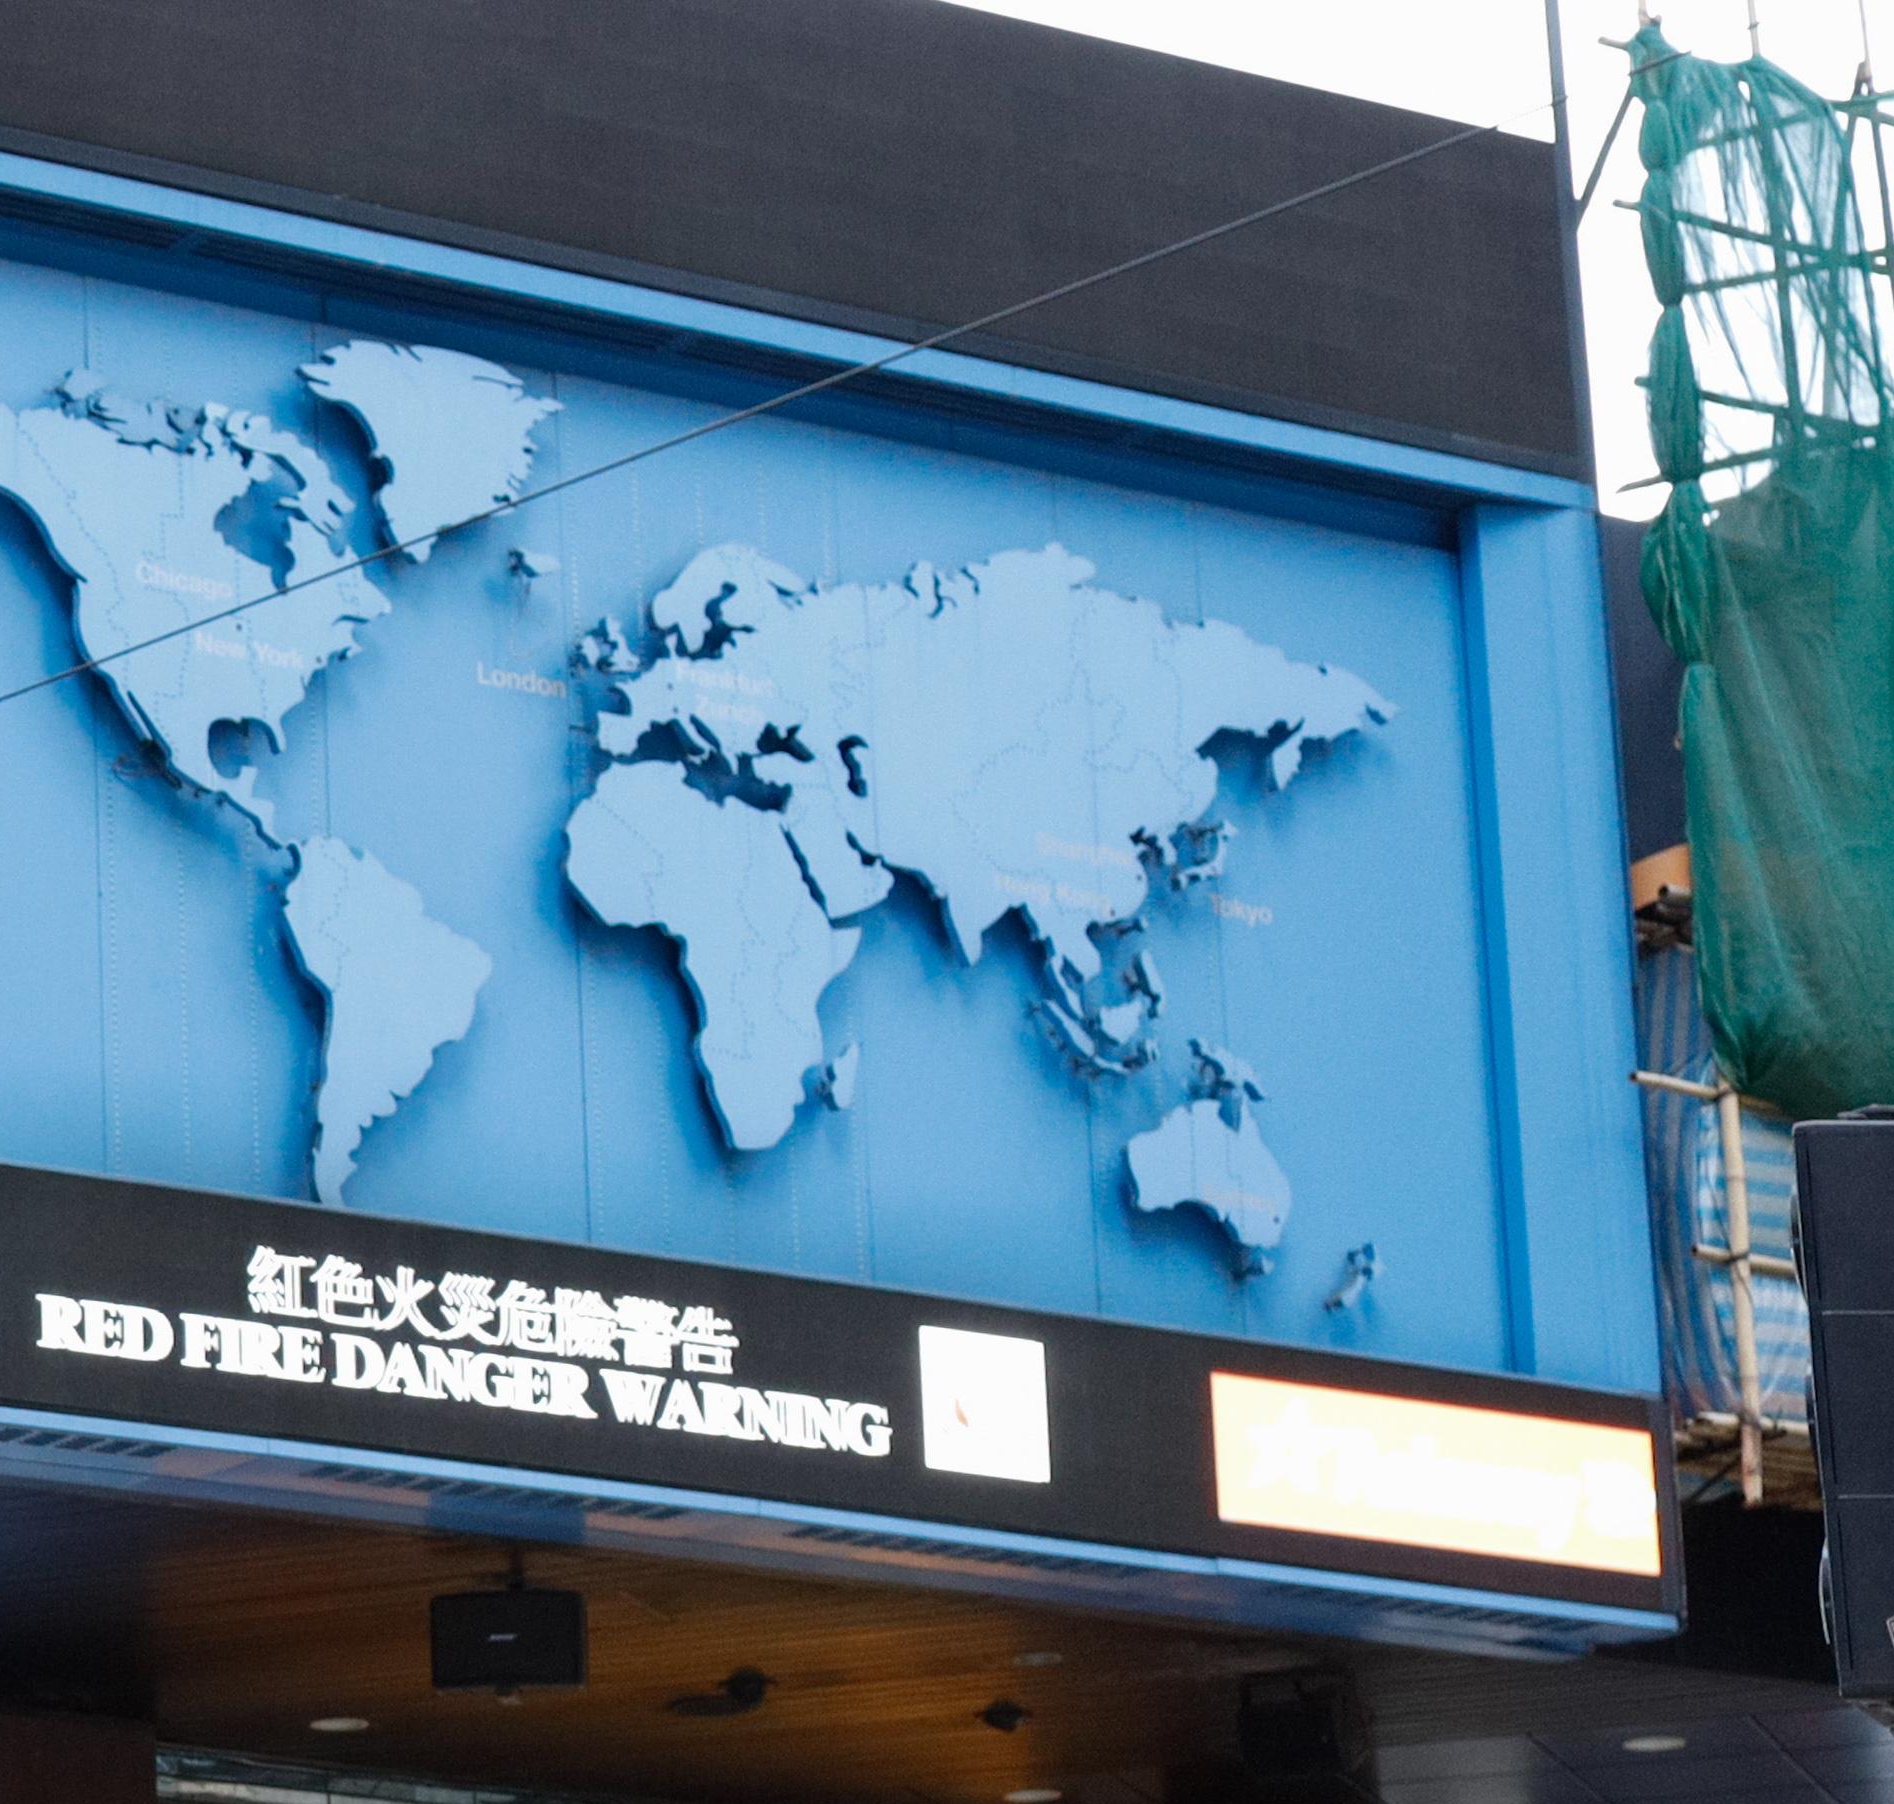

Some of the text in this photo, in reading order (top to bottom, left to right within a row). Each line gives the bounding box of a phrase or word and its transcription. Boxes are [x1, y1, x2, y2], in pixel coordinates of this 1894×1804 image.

[135, 559, 233, 601] Chicago
[196, 631, 306, 669] New York
[476, 660, 566, 698] London
[1210, 894, 1273, 928] Tokyo
[247, 1245, 740, 1375] 紅色火災危險警告
[35, 1293, 893, 1457] RED FIRE DANGER WARNING
